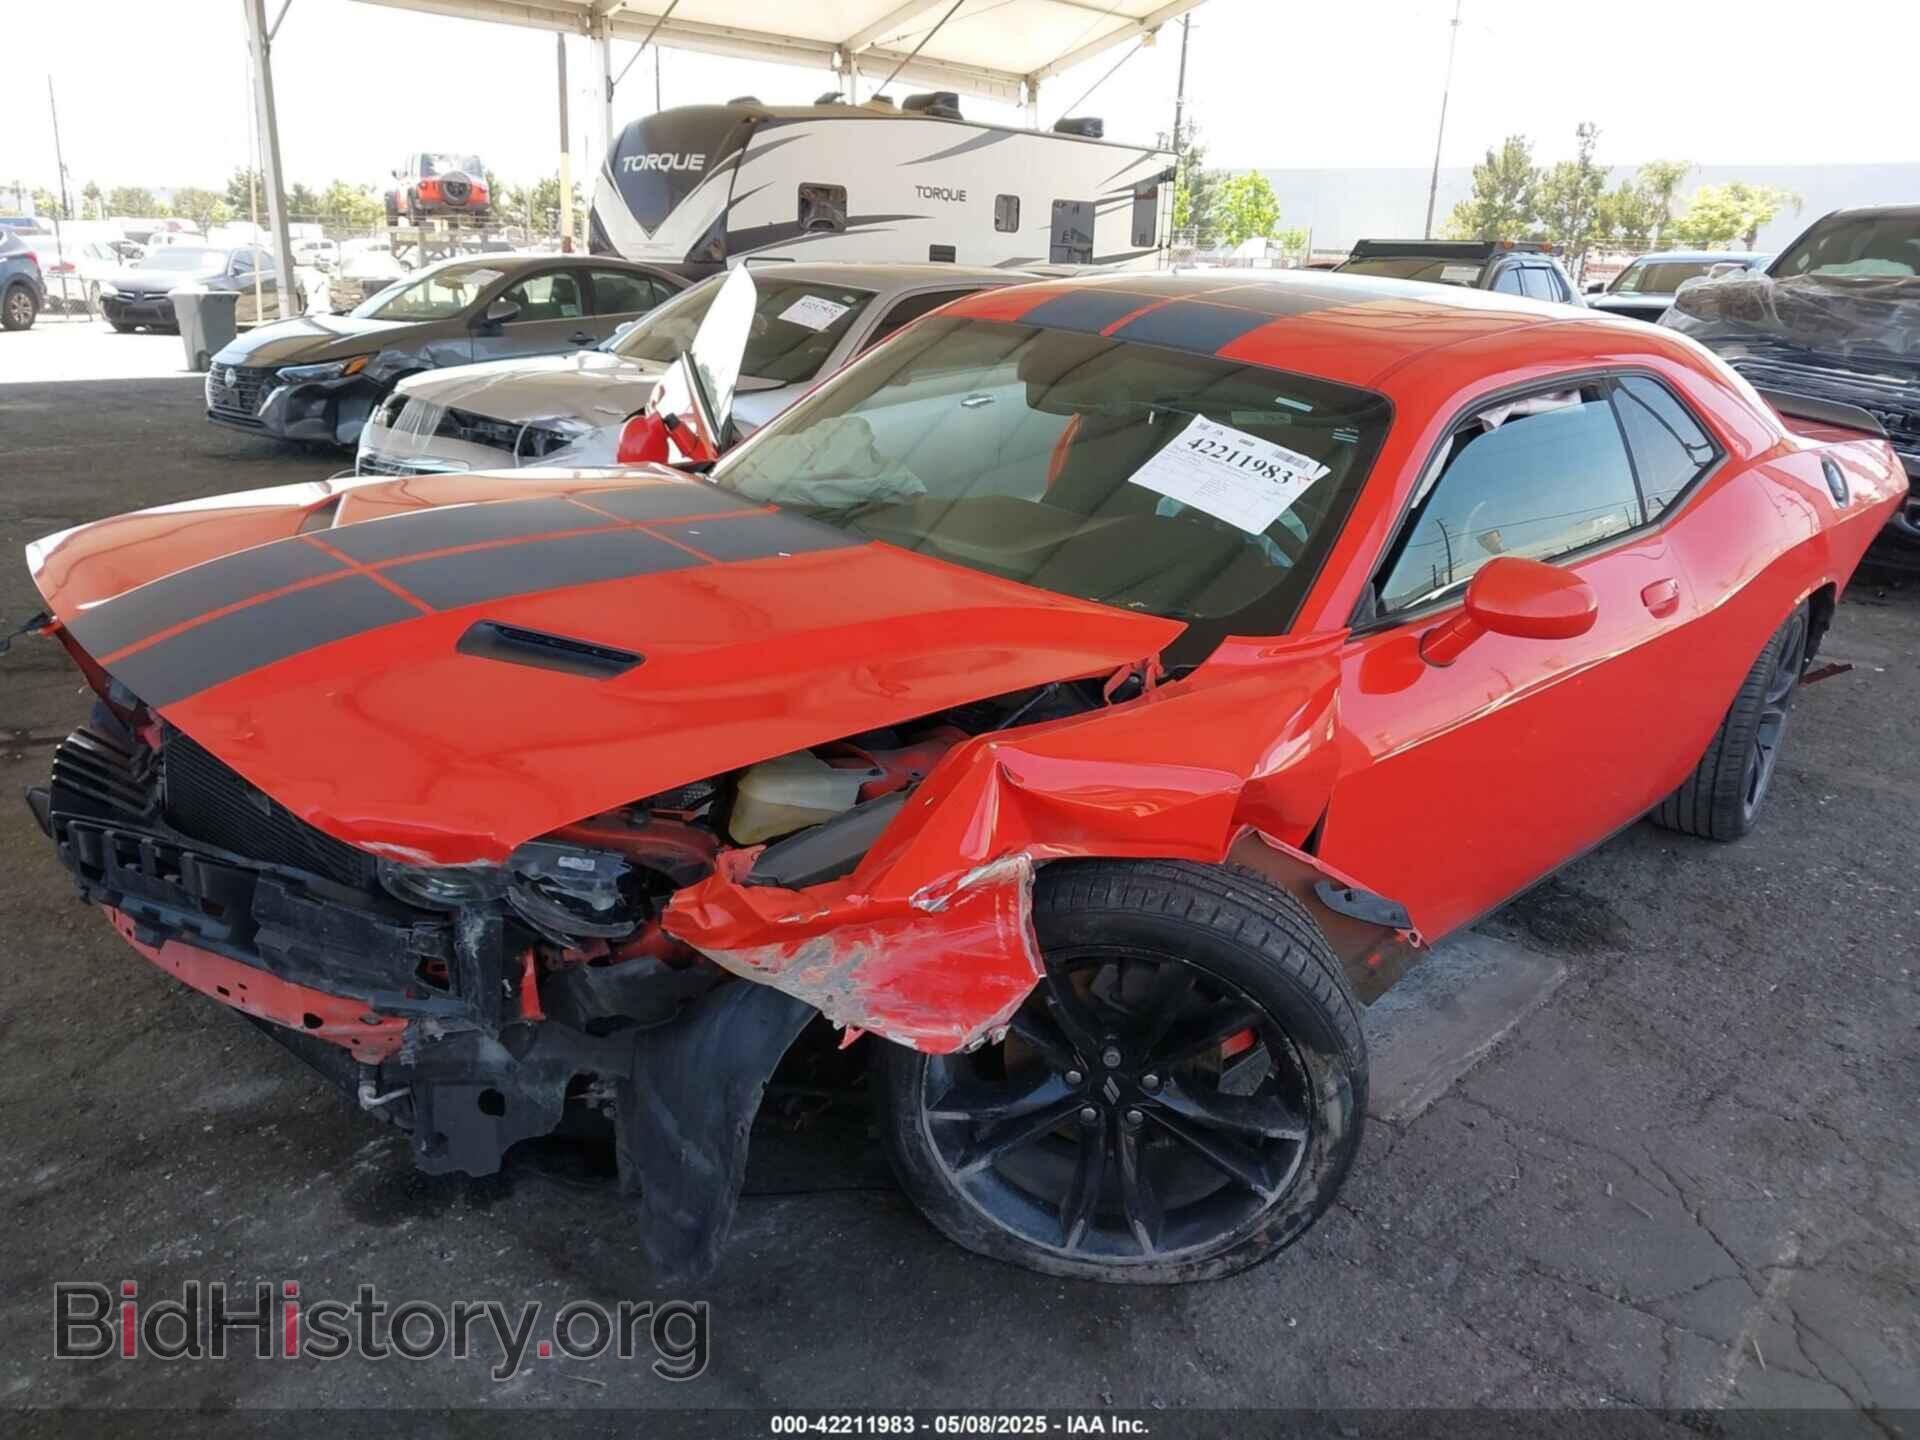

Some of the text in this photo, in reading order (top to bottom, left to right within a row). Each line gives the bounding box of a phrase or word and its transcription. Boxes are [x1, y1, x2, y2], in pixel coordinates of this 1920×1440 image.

[623, 153, 706, 173] TORQUE
[915, 185, 967, 202] TORQUE
[1187, 437, 1294, 485] 42211983
